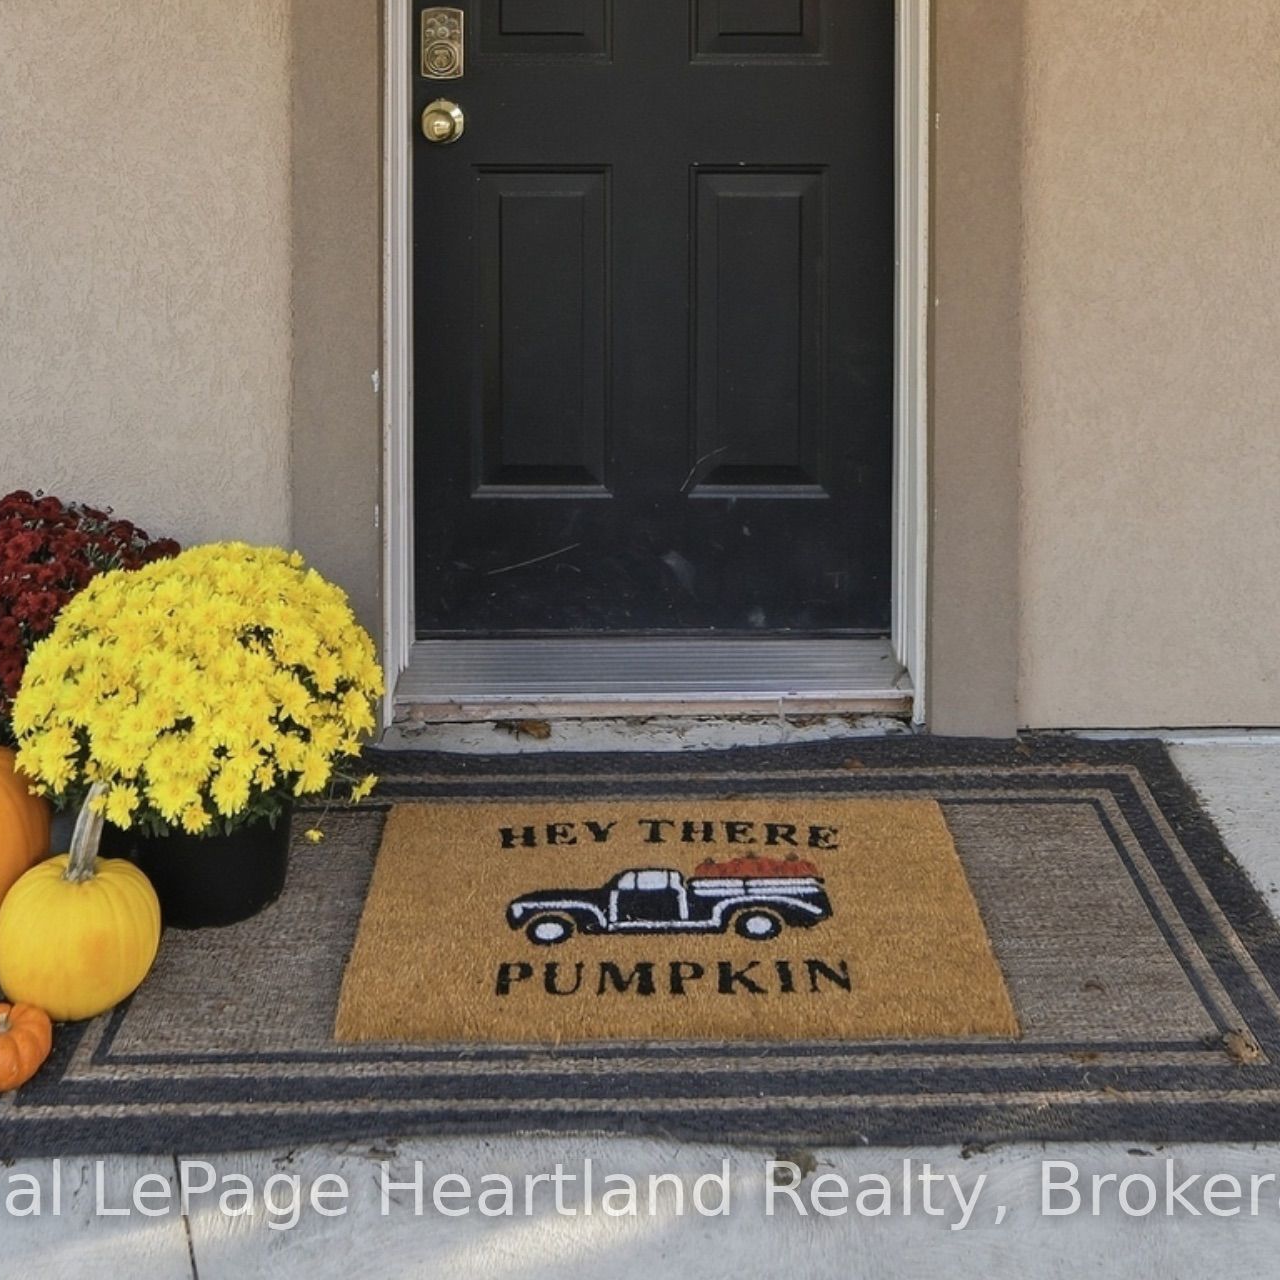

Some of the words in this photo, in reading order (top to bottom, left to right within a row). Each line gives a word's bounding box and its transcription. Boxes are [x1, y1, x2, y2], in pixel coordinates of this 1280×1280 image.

[499, 820, 618, 850] HEY
[639, 819, 840, 851] THERE
[494, 960, 852, 997] PUMPKIN
